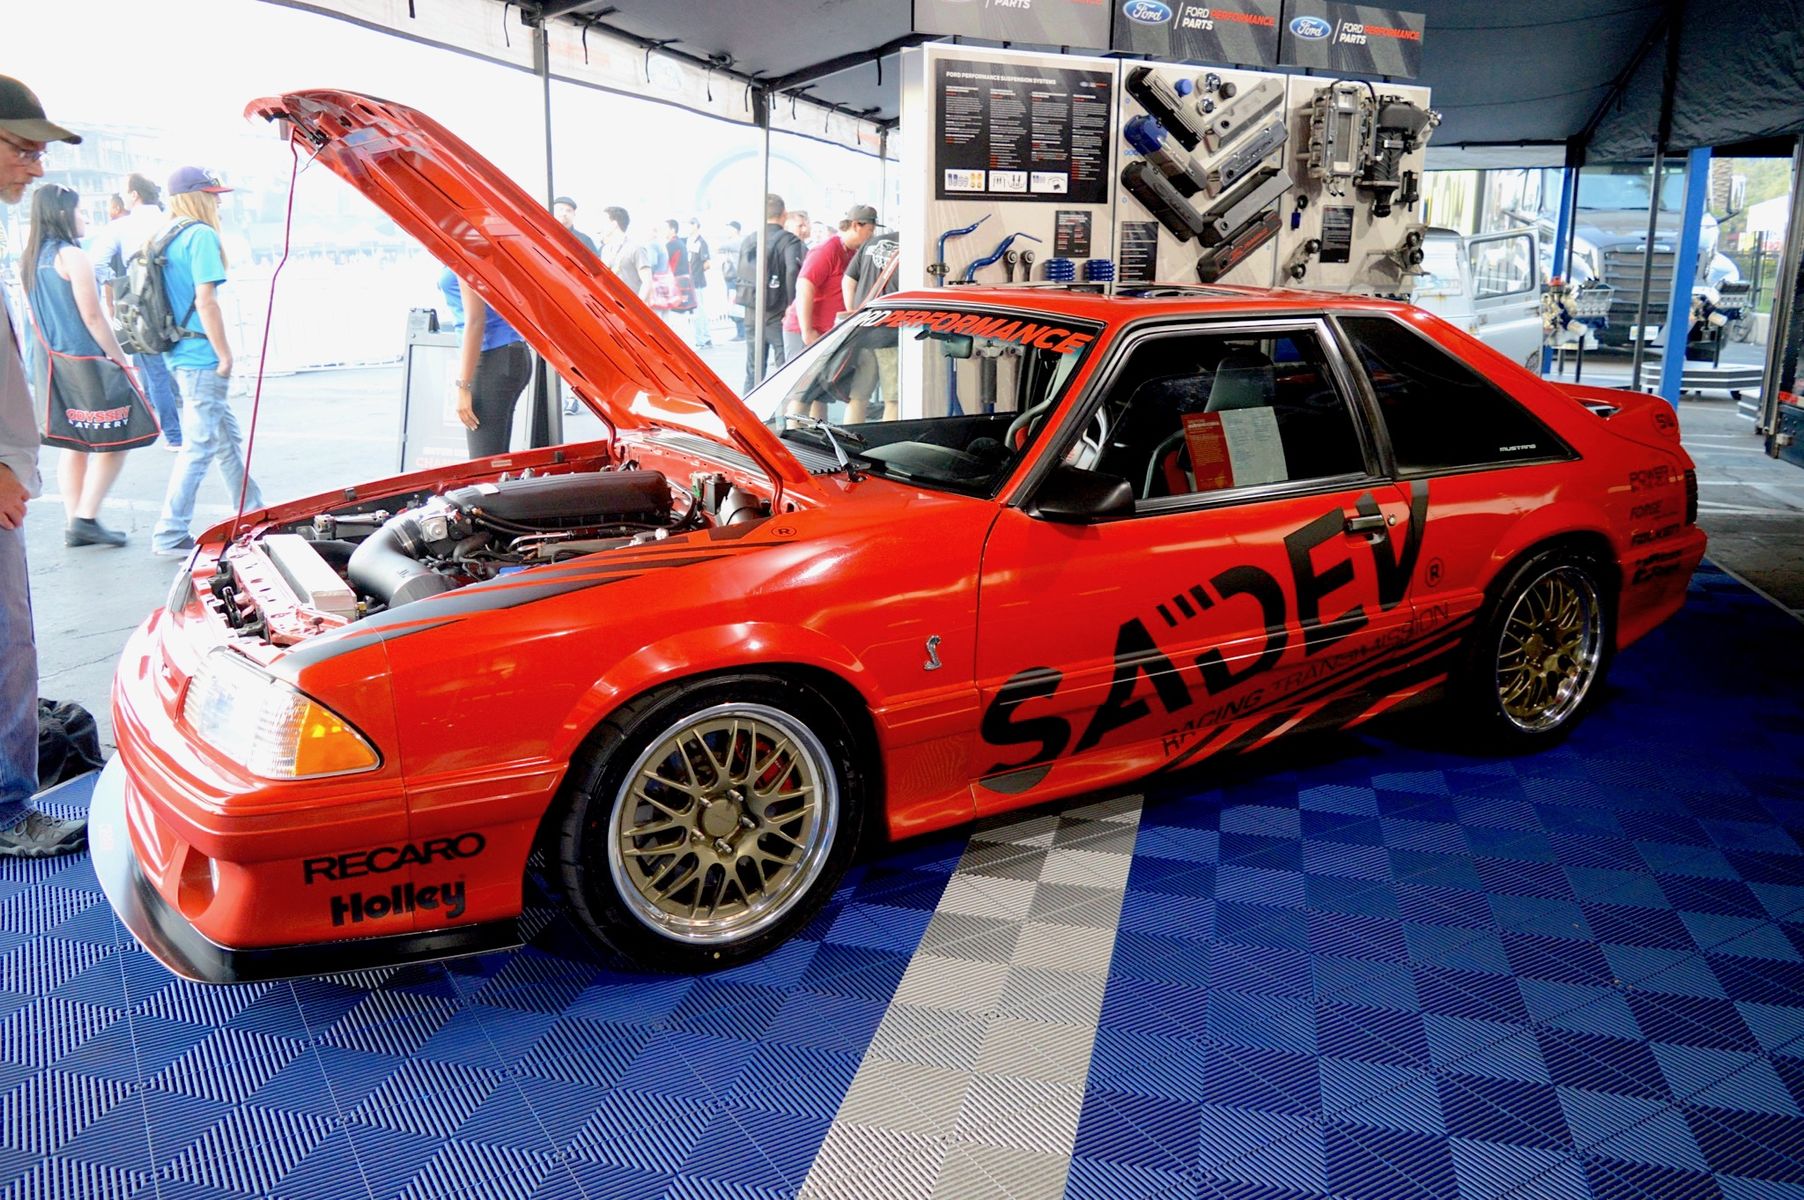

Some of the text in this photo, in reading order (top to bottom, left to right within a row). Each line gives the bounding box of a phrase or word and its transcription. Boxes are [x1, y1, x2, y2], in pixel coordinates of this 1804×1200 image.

[1130, 0, 1164, 22] Ford
[1185, 6, 1275, 27] FORD PERFORMANCE
[1182, 17, 1214, 31] PARTS
[1294, 18, 1325, 38] Ford
[1342, 22, 1421, 40] FORD PERFORMANCE
[1339, 33, 1368, 45] PARTS
[945, 71, 962, 79] FORD
[961, 72, 1000, 81] PERFORMANCE
[874, 309, 1095, 354] PERFORMANCE
[66, 405, 131, 423] ODYSSEY
[979, 479, 1430, 795] SADEV
[1160, 600, 1450, 757] RACING TRANSMISSION
[303, 832, 487, 885] RECARO
[329, 878, 466, 928] Holley
